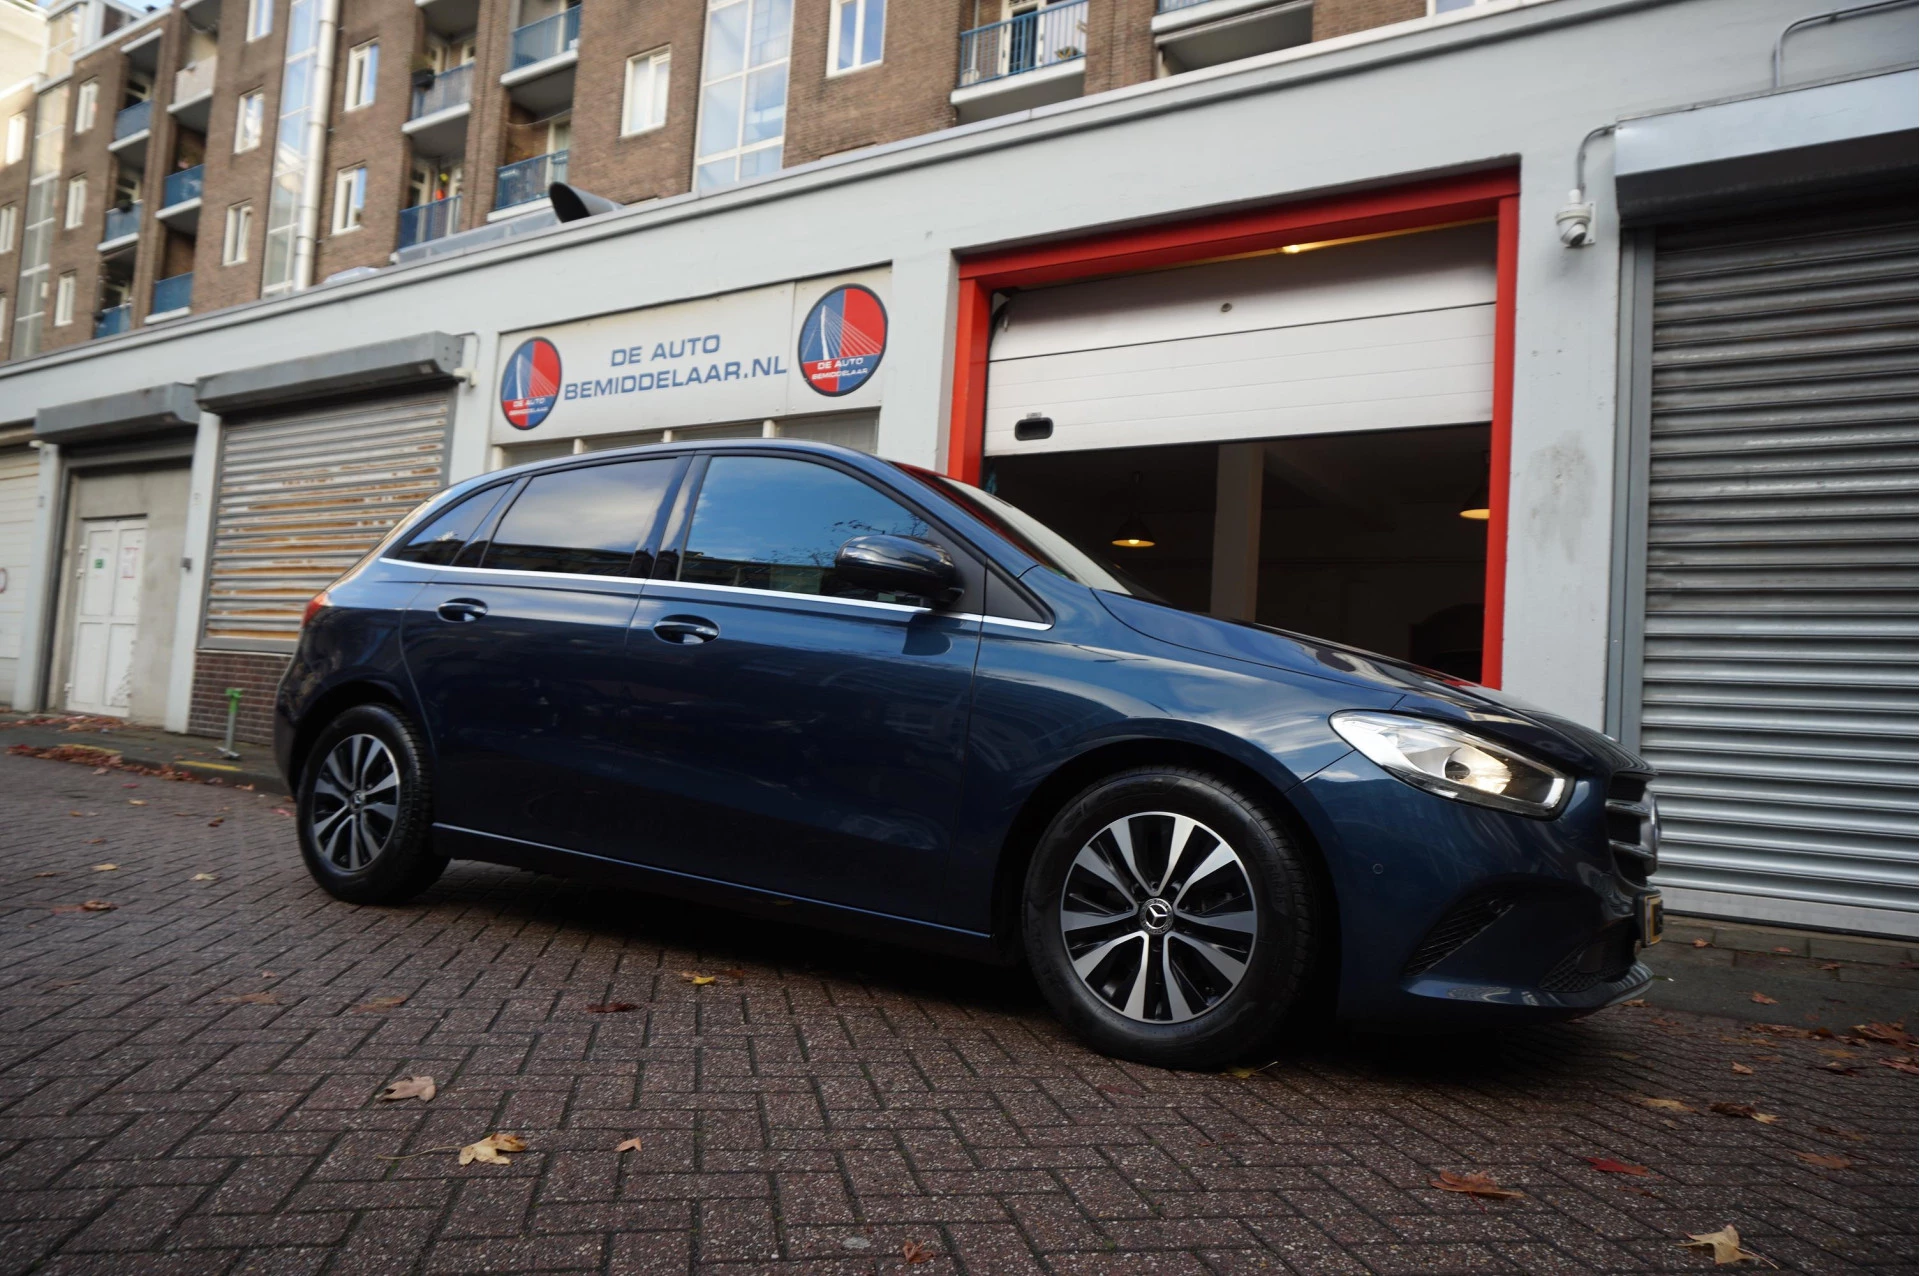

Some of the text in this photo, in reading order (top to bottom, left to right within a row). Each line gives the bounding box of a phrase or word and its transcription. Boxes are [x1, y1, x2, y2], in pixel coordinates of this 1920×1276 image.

[611, 334, 720, 366] DE AUTO
[817, 357, 864, 370] DE AUTO
[564, 356, 787, 400] BEMIDDELAAR.NL
